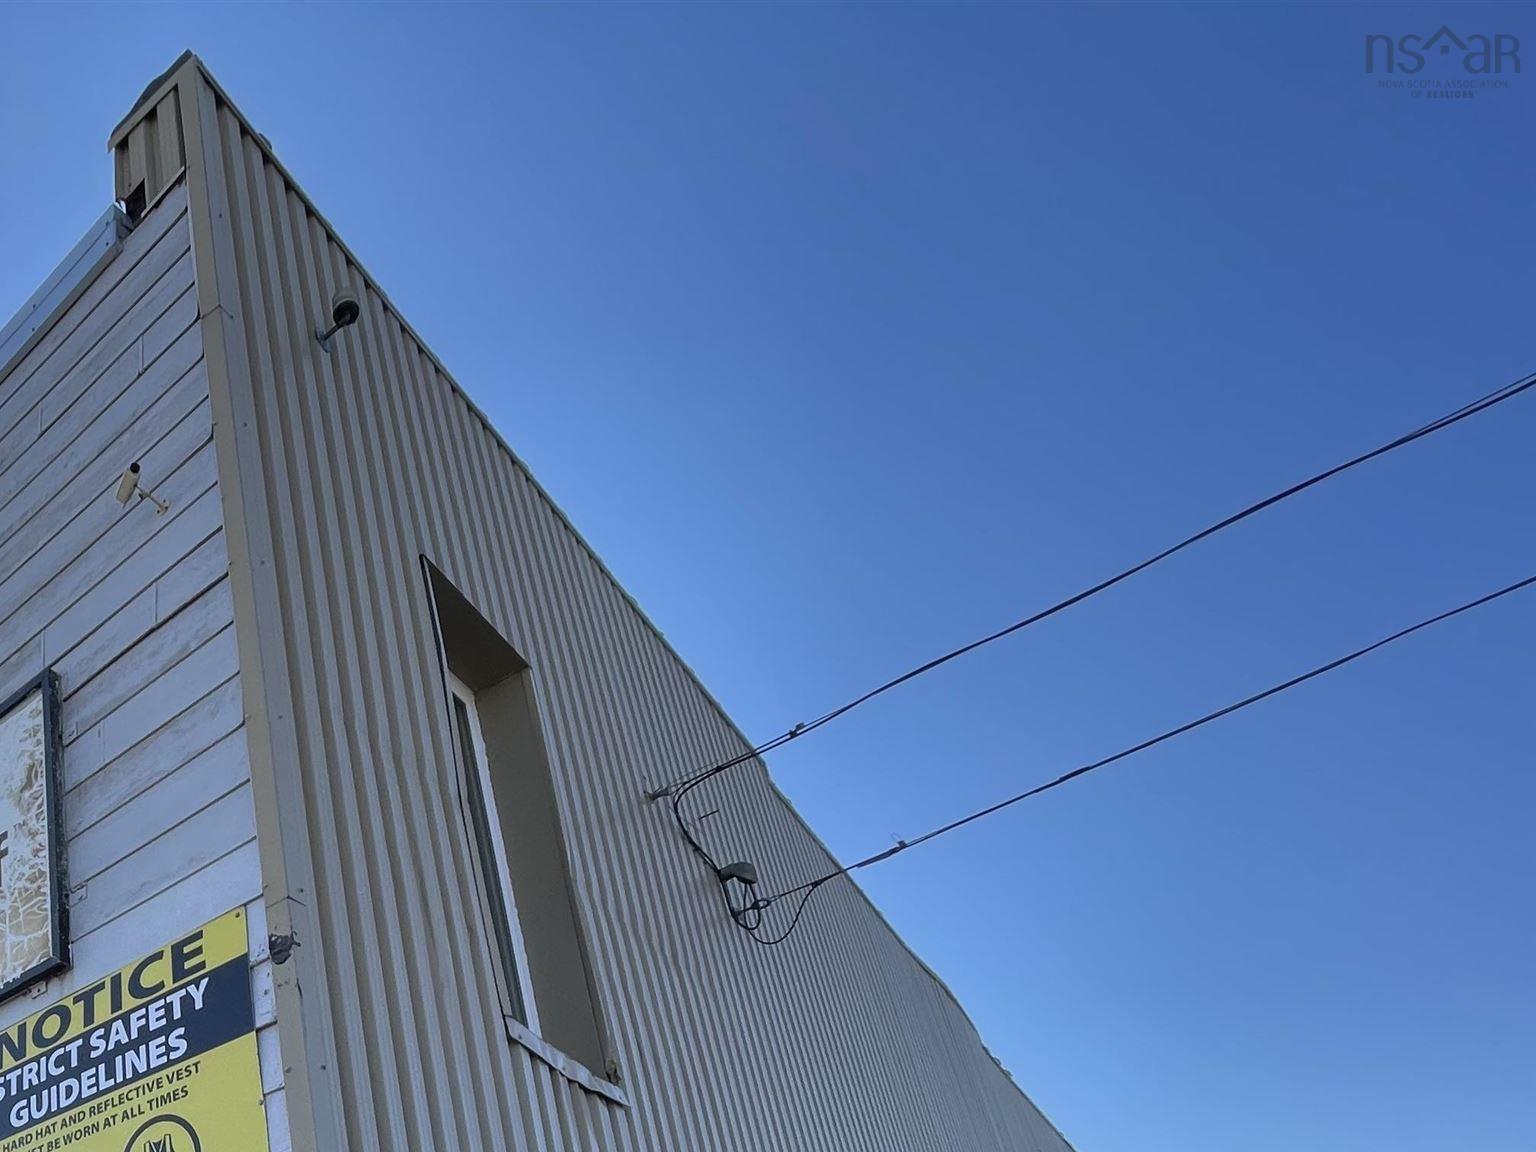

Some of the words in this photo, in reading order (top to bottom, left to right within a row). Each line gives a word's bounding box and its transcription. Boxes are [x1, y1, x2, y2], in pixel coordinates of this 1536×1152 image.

[89, 976, 210, 1059] SAFETY
[8, 1026, 188, 1128] GUIDELINES
[35, 1120, 58, 1142] HAT
[60, 1110, 86, 1130] AND
[89, 1075, 164, 1117] REFLECTIVE
[165, 1060, 202, 1085] VEST
[46, 1137, 62, 1152] BE
[63, 1121, 100, 1146] WORN
[102, 1113, 117, 1130] AT
[120, 1104, 146, 1124] ALL
[146, 1084, 189, 1111] TIMES
